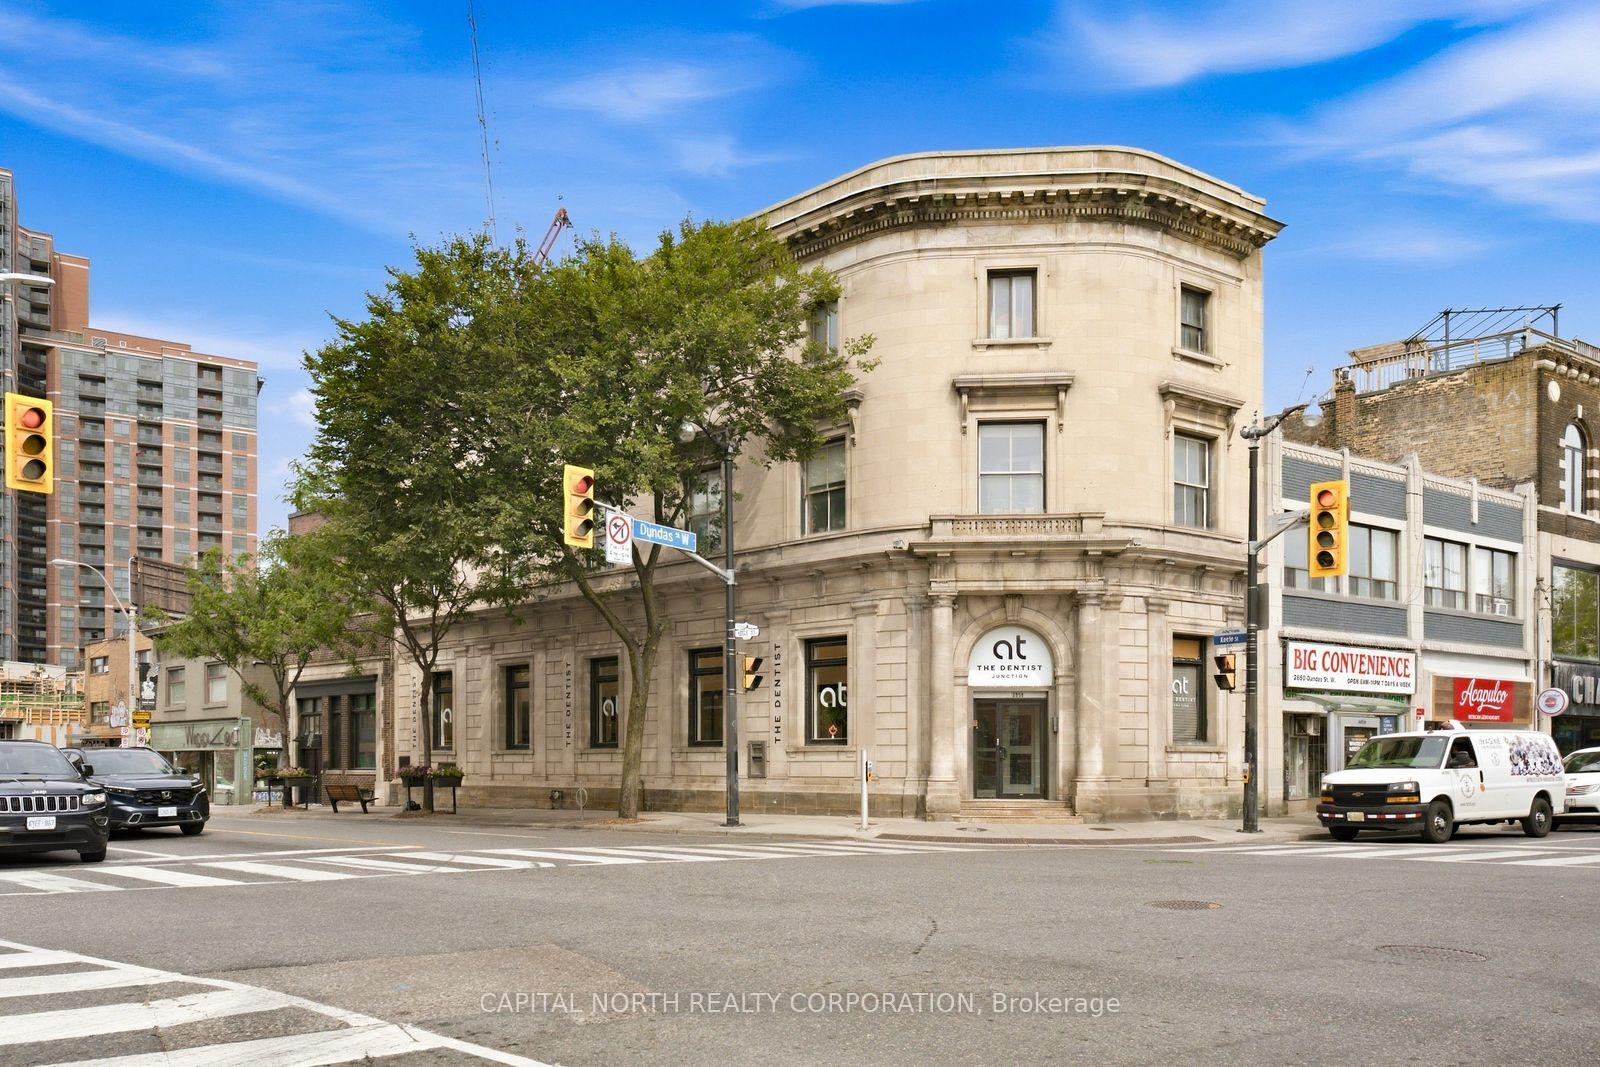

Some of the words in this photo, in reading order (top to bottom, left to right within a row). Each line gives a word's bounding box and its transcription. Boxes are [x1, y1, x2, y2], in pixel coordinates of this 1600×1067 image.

[640, 523, 674, 542] Dundas
[681, 533, 690, 546] W
[993, 635, 1027, 660] at
[1293, 648, 1317, 671] BIG
[1321, 651, 1410, 678] CONVENIENCE
[1460, 678, 1508, 712] Acapulco
[1571, 675, 1600, 705] CH
